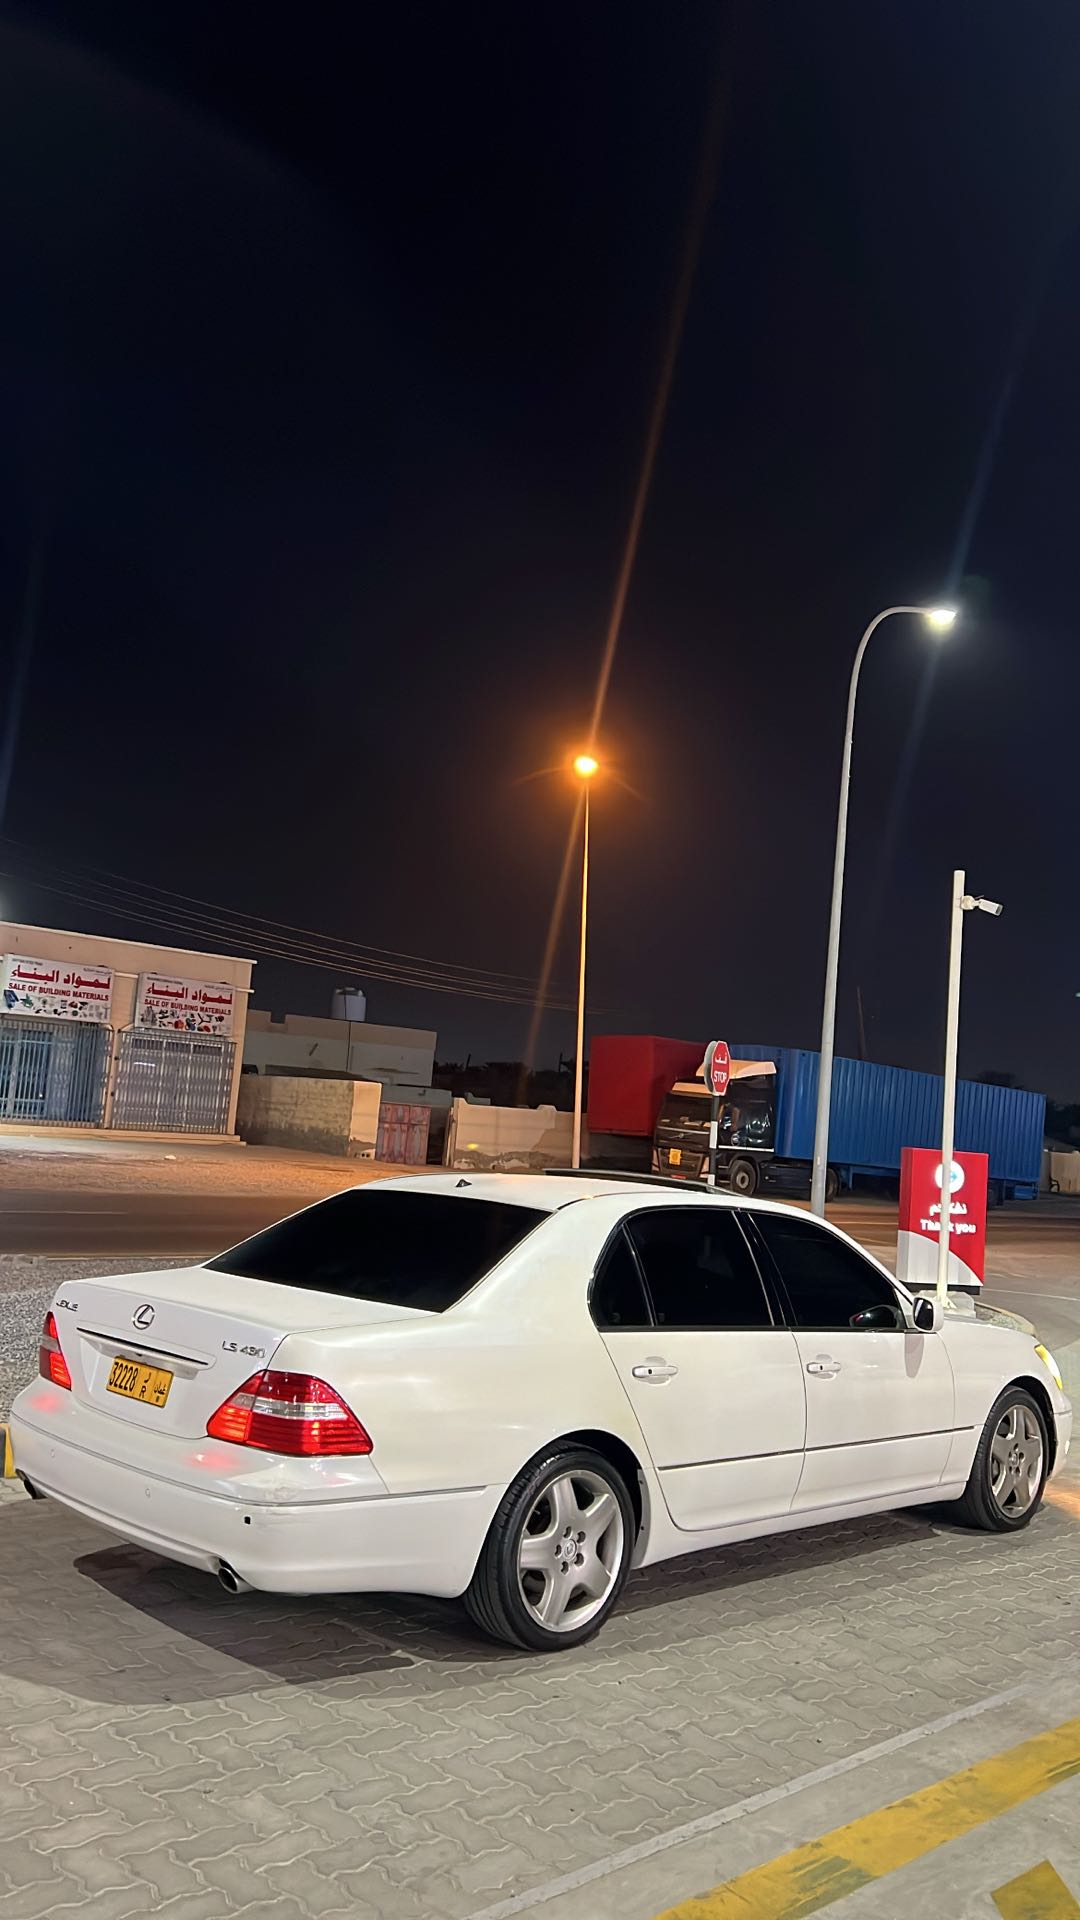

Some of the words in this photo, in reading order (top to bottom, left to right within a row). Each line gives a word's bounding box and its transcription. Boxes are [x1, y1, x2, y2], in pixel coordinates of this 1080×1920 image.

[10, 964, 60, 985] البناء
[8, 982, 26, 992] SALE
[27, 985, 38, 993] OF
[38, 986, 71, 997] BUILDING
[72, 990, 110, 1001] MATERIALS
[145, 982, 189, 1001] البناء
[144, 999, 160, 1007] SALE
[170, 1002, 199, 1013] BUILDING
[199, 1007, 232, 1016] MATERIALS
[714, 1070, 728, 1083] STOP
[920, 1219, 955, 1232] Thak
[955, 1222, 976, 1235] you
[222, 1340, 238, 1353] LS
[239, 1345, 266, 1359] 430
[109, 1361, 139, 1393] 32228
[139, 1385, 147, 1399] R
